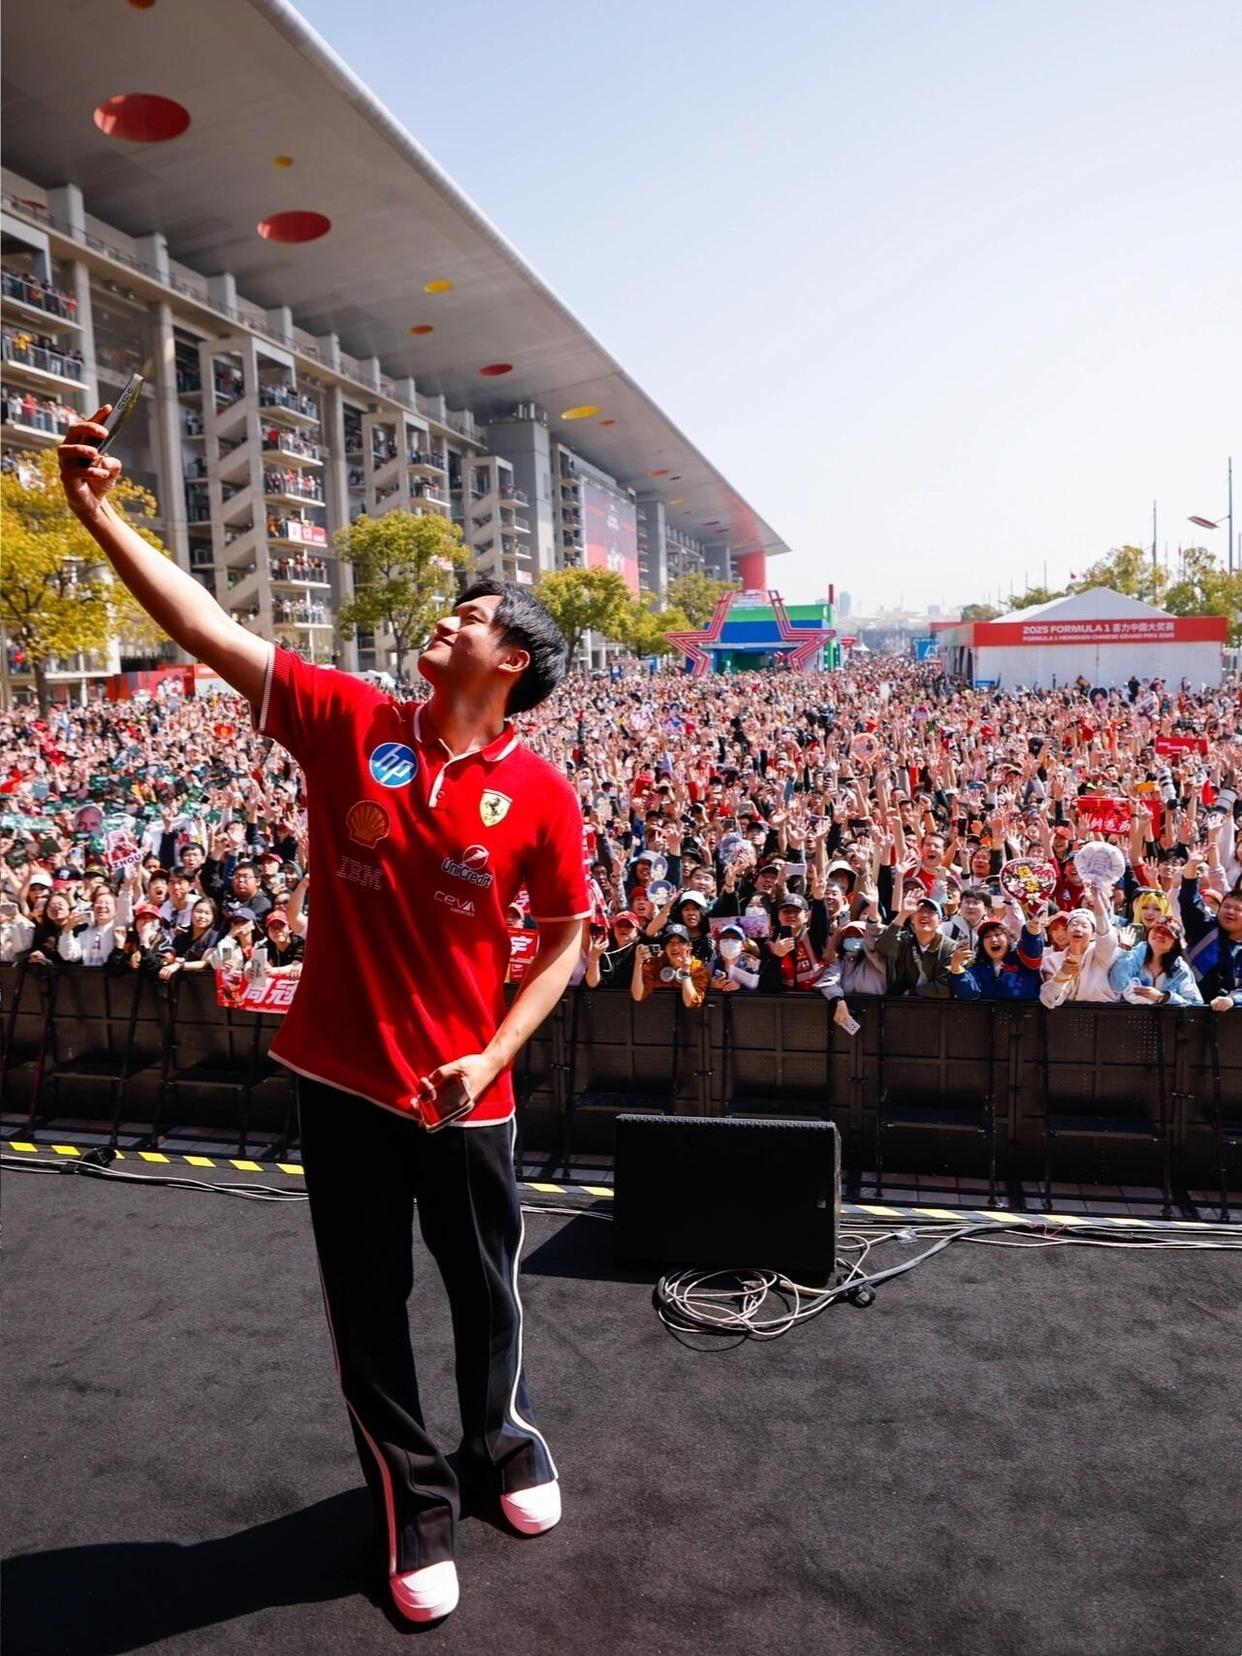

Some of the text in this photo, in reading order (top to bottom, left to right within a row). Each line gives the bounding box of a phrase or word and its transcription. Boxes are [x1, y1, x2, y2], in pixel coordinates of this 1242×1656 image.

[1023, 625, 1049, 634] 2025
[1050, 624, 1104, 633] FORMULA
[1104, 624, 1110, 633] 1
[374, 745, 415, 783] hp
[112, 854, 141, 869] ZHOU
[336, 855, 384, 892] IBM
[442, 857, 493, 889] UniCredit
